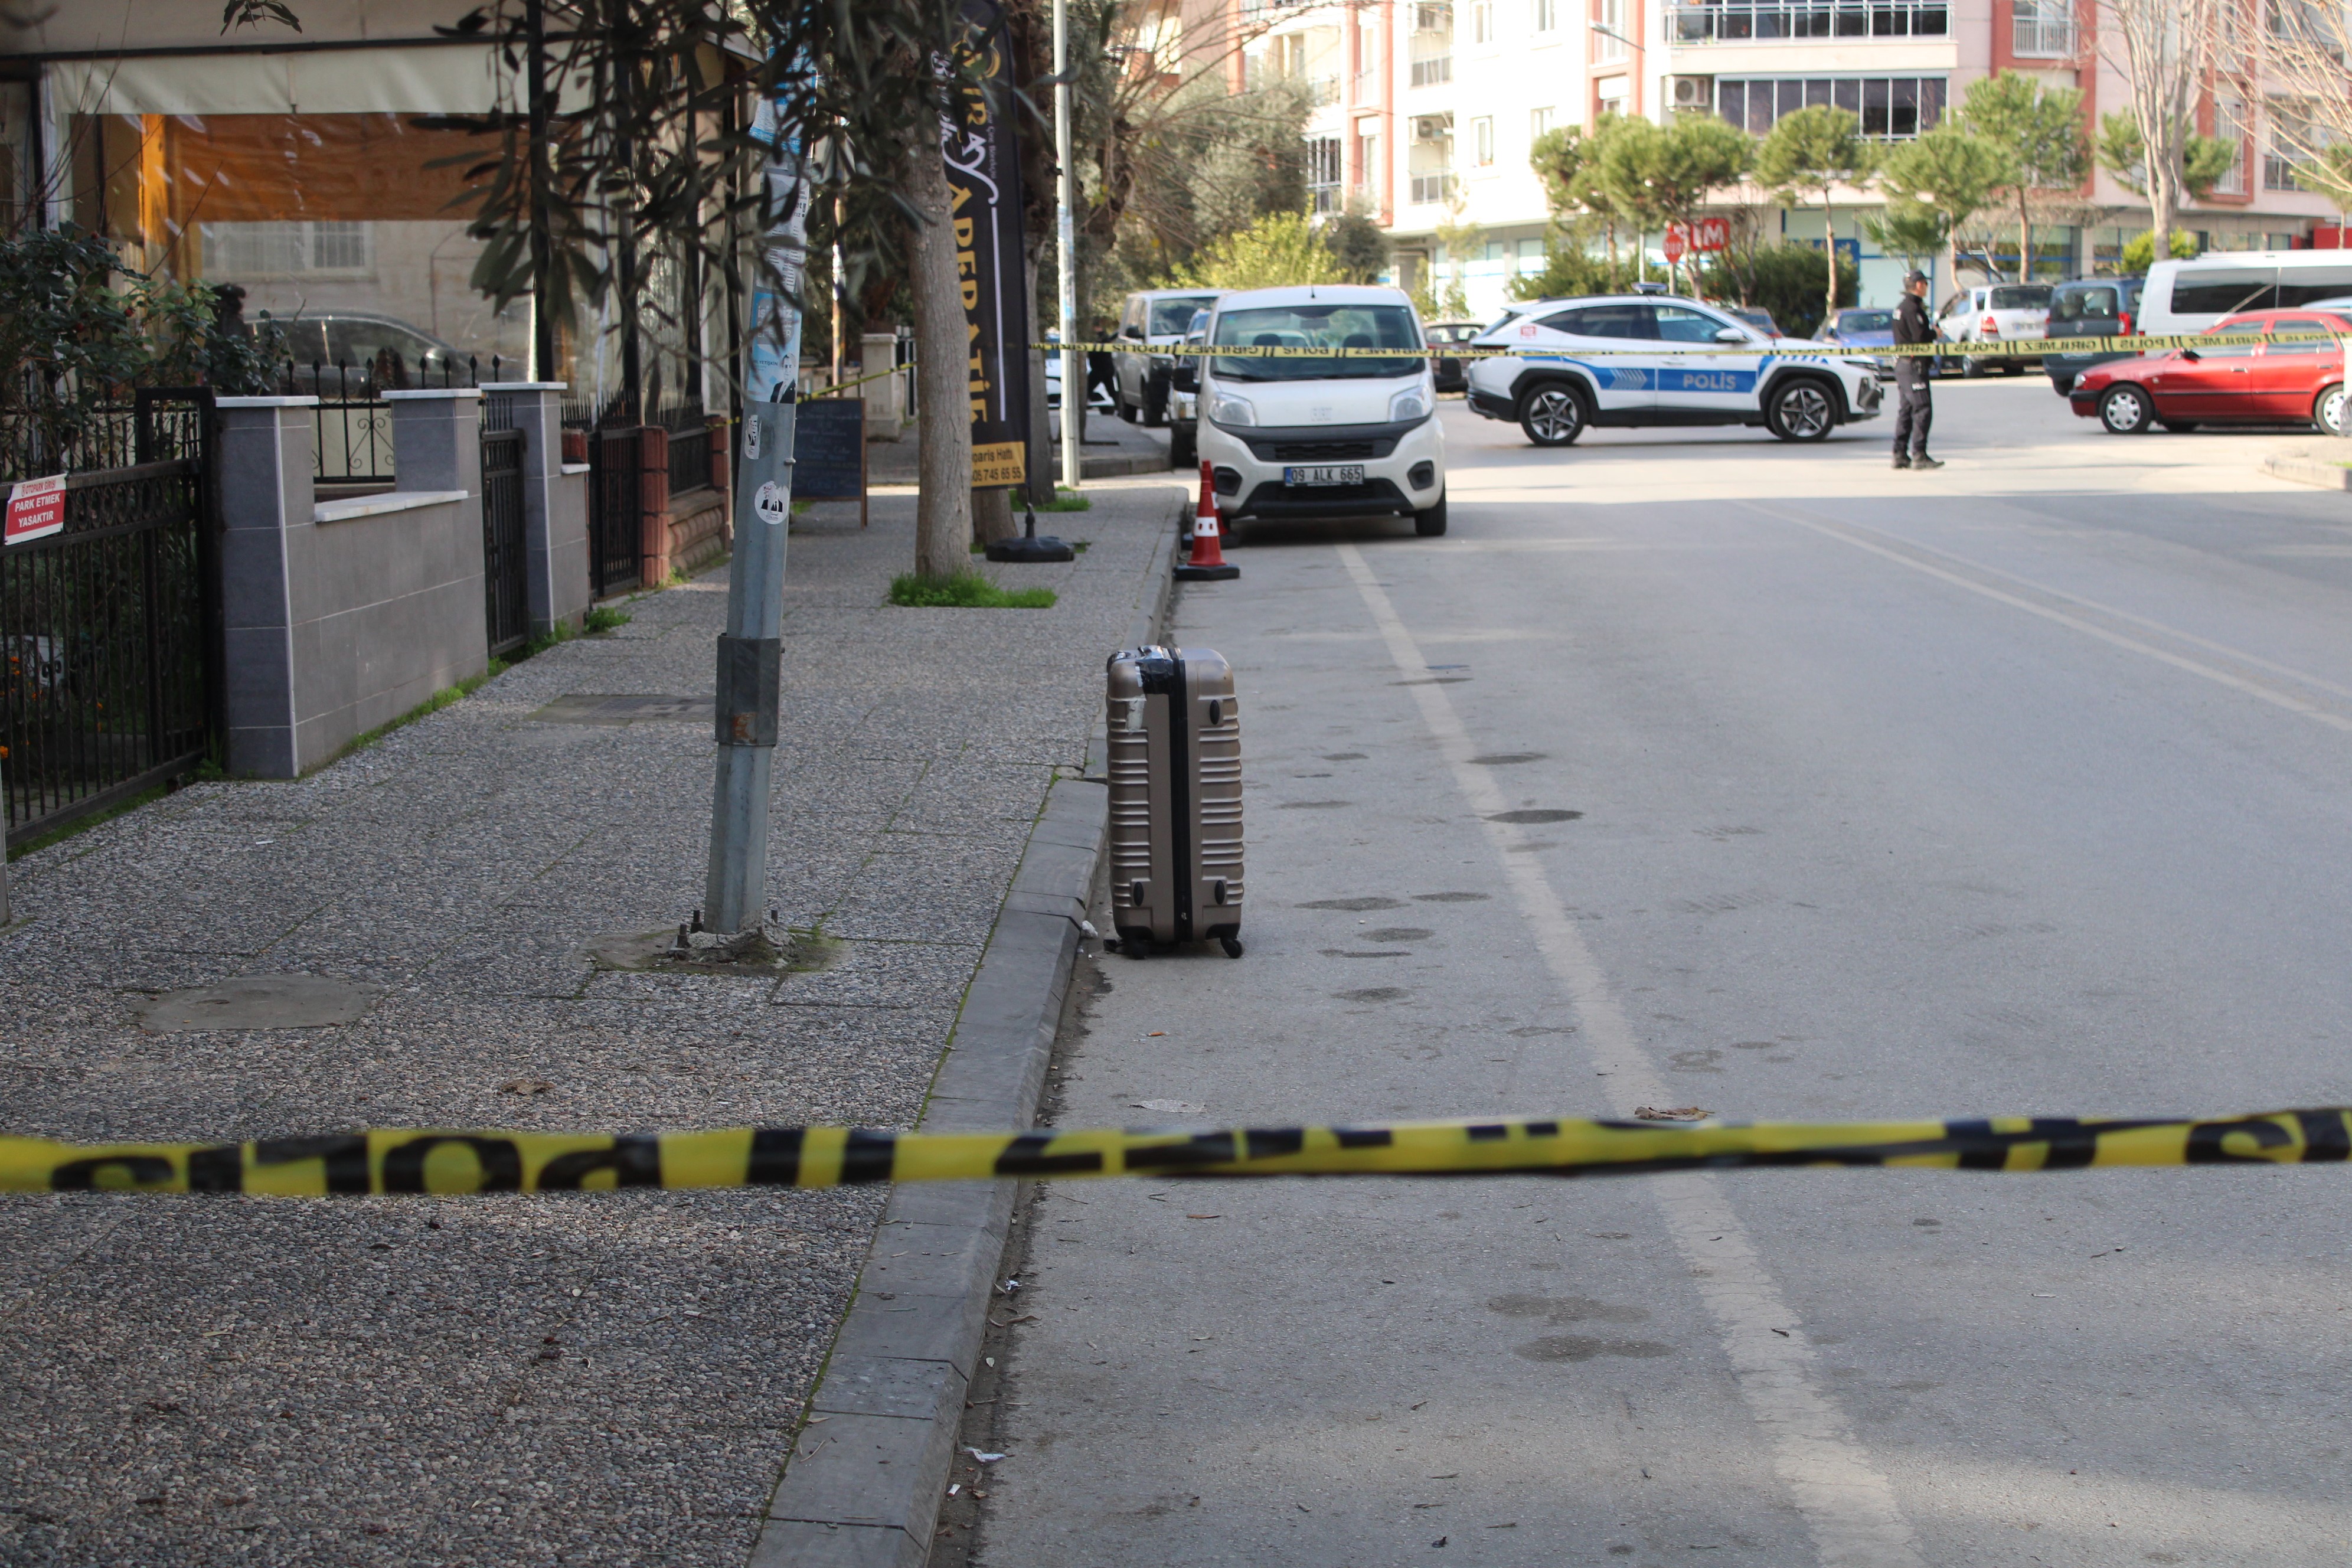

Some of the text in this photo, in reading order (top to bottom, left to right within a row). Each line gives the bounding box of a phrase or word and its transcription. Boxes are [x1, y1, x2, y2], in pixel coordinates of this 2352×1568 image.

[1683, 372, 1736, 390] POLİS
[1291, 468, 1361, 482] 09 ALK 665
[25, 482, 44, 494] OTOPARK
[15, 493, 60, 512] PARK ETMEK
[18, 510, 54, 528] YASAKTIR
